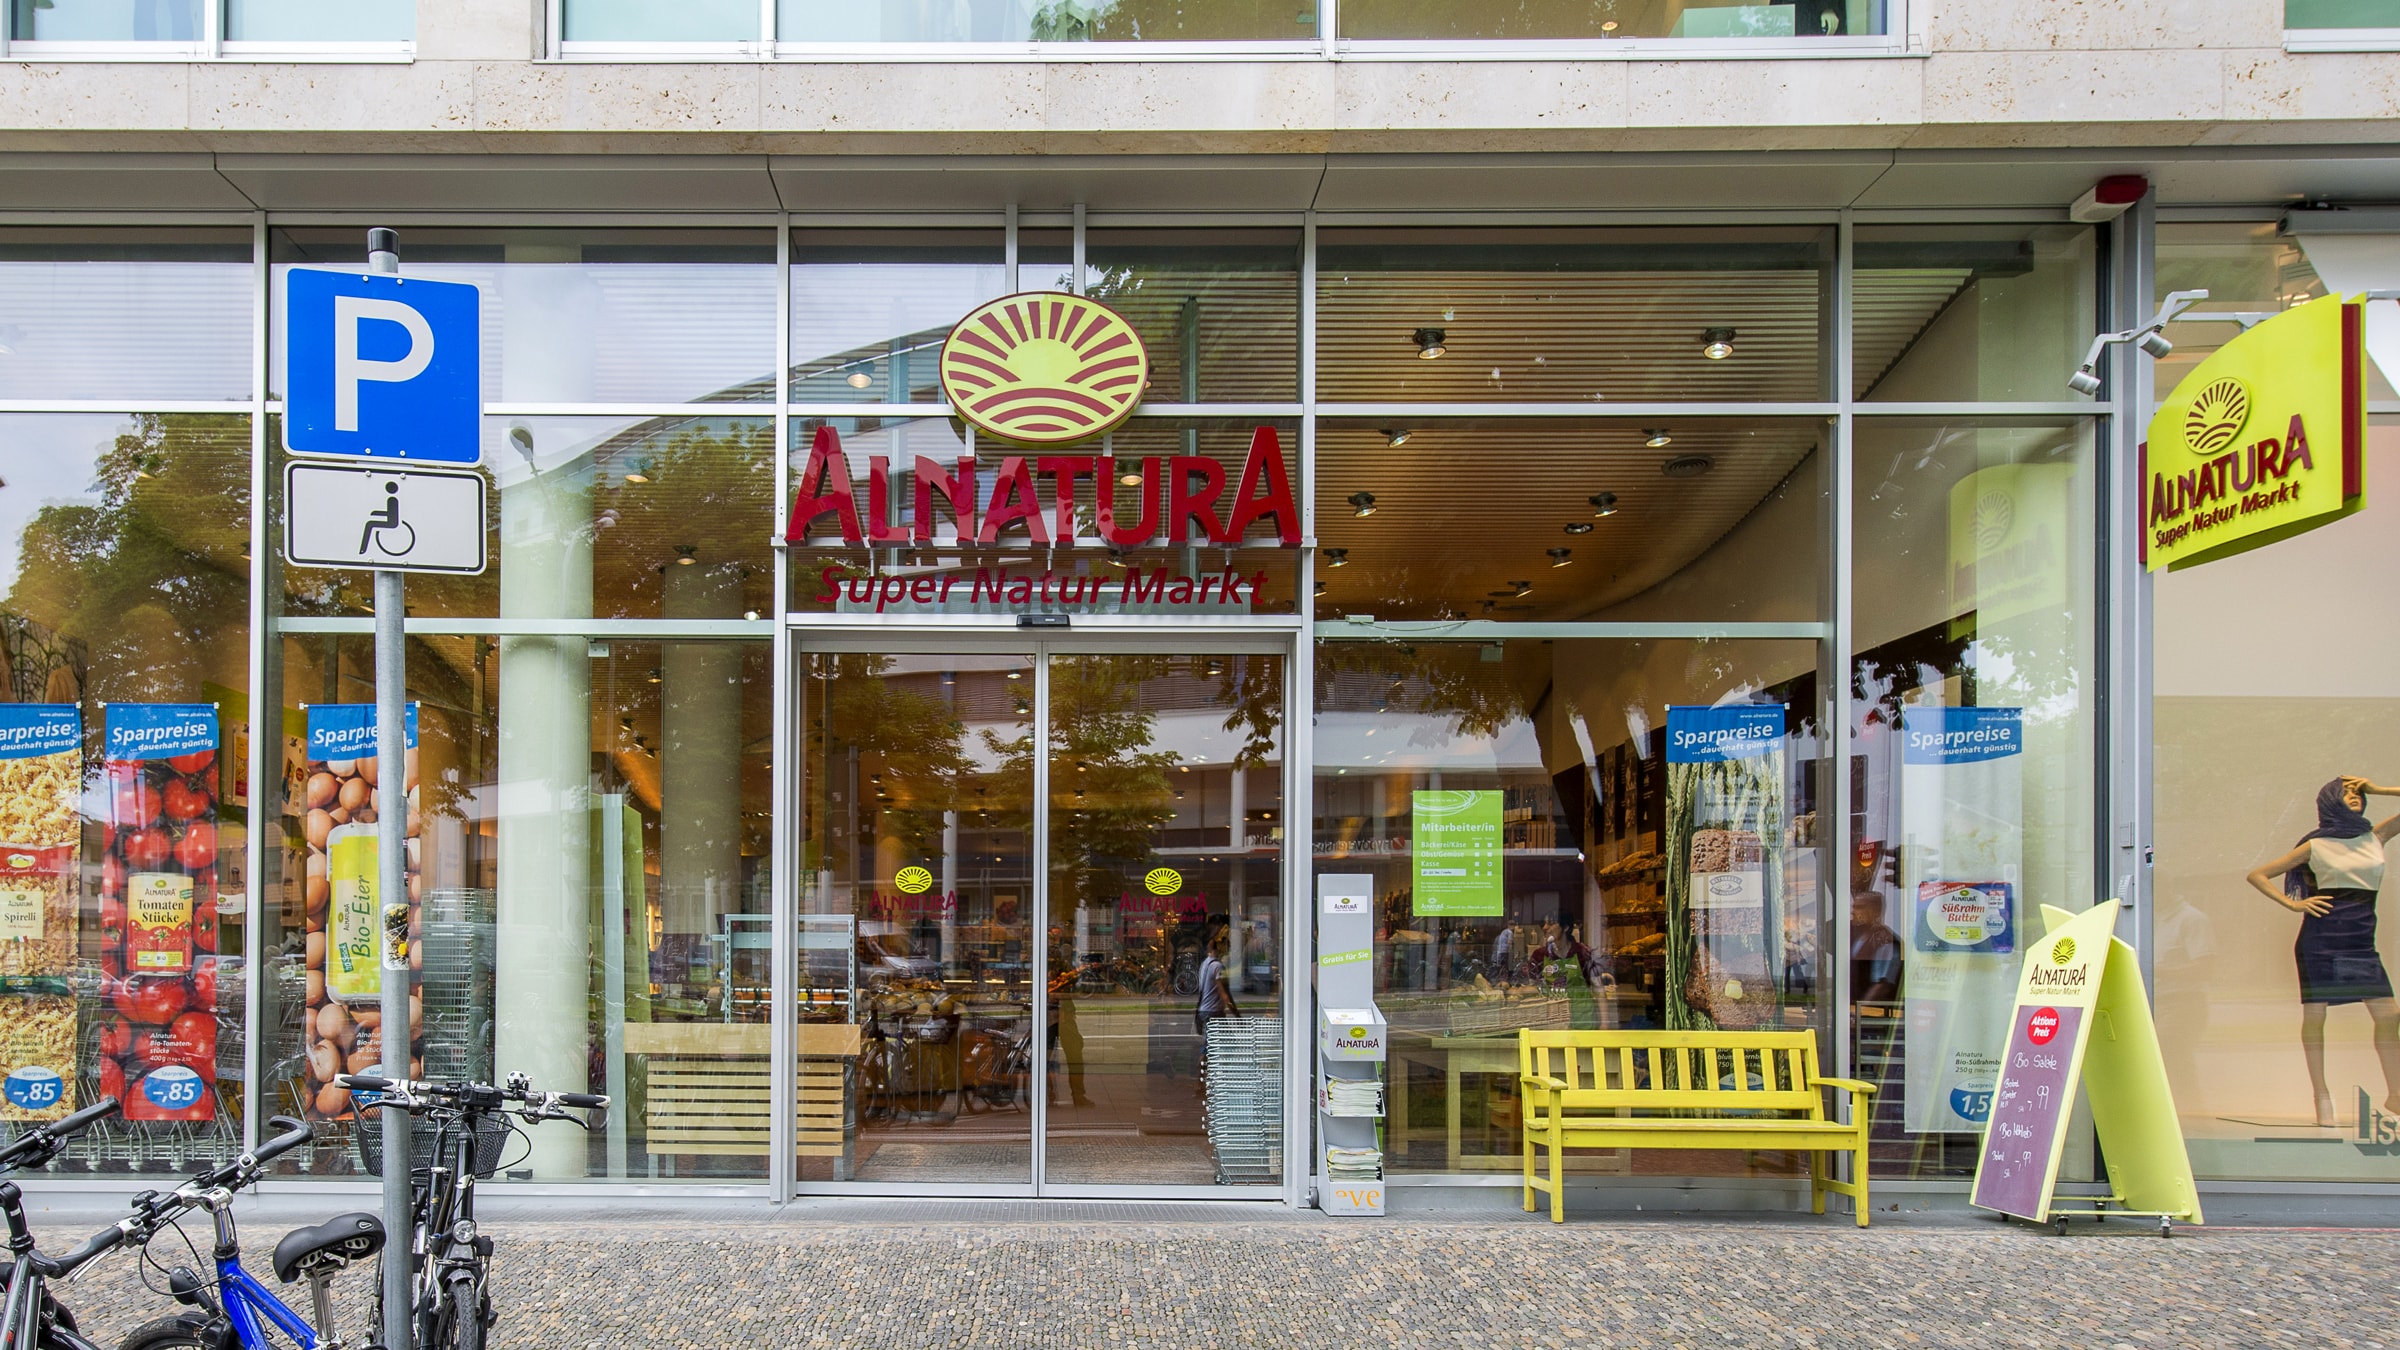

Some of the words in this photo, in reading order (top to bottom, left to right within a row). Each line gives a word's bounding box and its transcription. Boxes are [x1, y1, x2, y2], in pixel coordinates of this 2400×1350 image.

[335, 295, 435, 432] P
[2150, 413, 2313, 529] ALNATURA
[785, 426, 1302, 549] ALNATURA
[2155, 520, 2191, 549] Super
[2192, 503, 2238, 532] Natur
[2240, 480, 2300, 516] Markt
[815, 565, 959, 614] Super
[971, 566, 1114, 605] Natur
[1120, 565, 1269, 605] Markt
[112, 721, 208, 746] Sparpreise
[314, 725, 378, 747] Sparpre
[1674, 722, 1773, 749] Sparpreise
[1910, 725, 2011, 751] Sparpreise
[181, 739, 213, 750] günstig
[1746, 740, 1779, 751] günstig
[1983, 743, 2017, 754] günstig
[1421, 822, 1495, 832] Mitarbeiter/in
[137, 899, 184, 911] Tomaten
[869, 890, 958, 911] ALNATURA
[1119, 891, 1208, 912] ALNATURA
[1941, 903, 1985, 913] Süßrahm
[4, 911, 37, 923] Spirelli
[142, 911, 180, 923] Stücke
[351, 875, 371, 957] Bio-Eier
[1948, 913, 1980, 922] Butter
[1322, 955, 1344, 964] Gratis
[1346, 952, 1357, 961] für
[1358, 951, 1369, 959] Sie
[2029, 963, 2087, 986] ALNATURA
[2029, 987, 2046, 997] Super
[2046, 987, 2062, 996] Natur
[2063, 987, 2081, 996] Markt
[2031, 1015, 2057, 1026] Aktions
[1336, 1037, 1380, 1048] ALNATURA
[2033, 1027, 2050, 1037] Preis
[13, 1082, 57, 1103] -,85
[153, 1082, 196, 1103] -,85
[1961, 1094, 1994, 1115] 1,5
